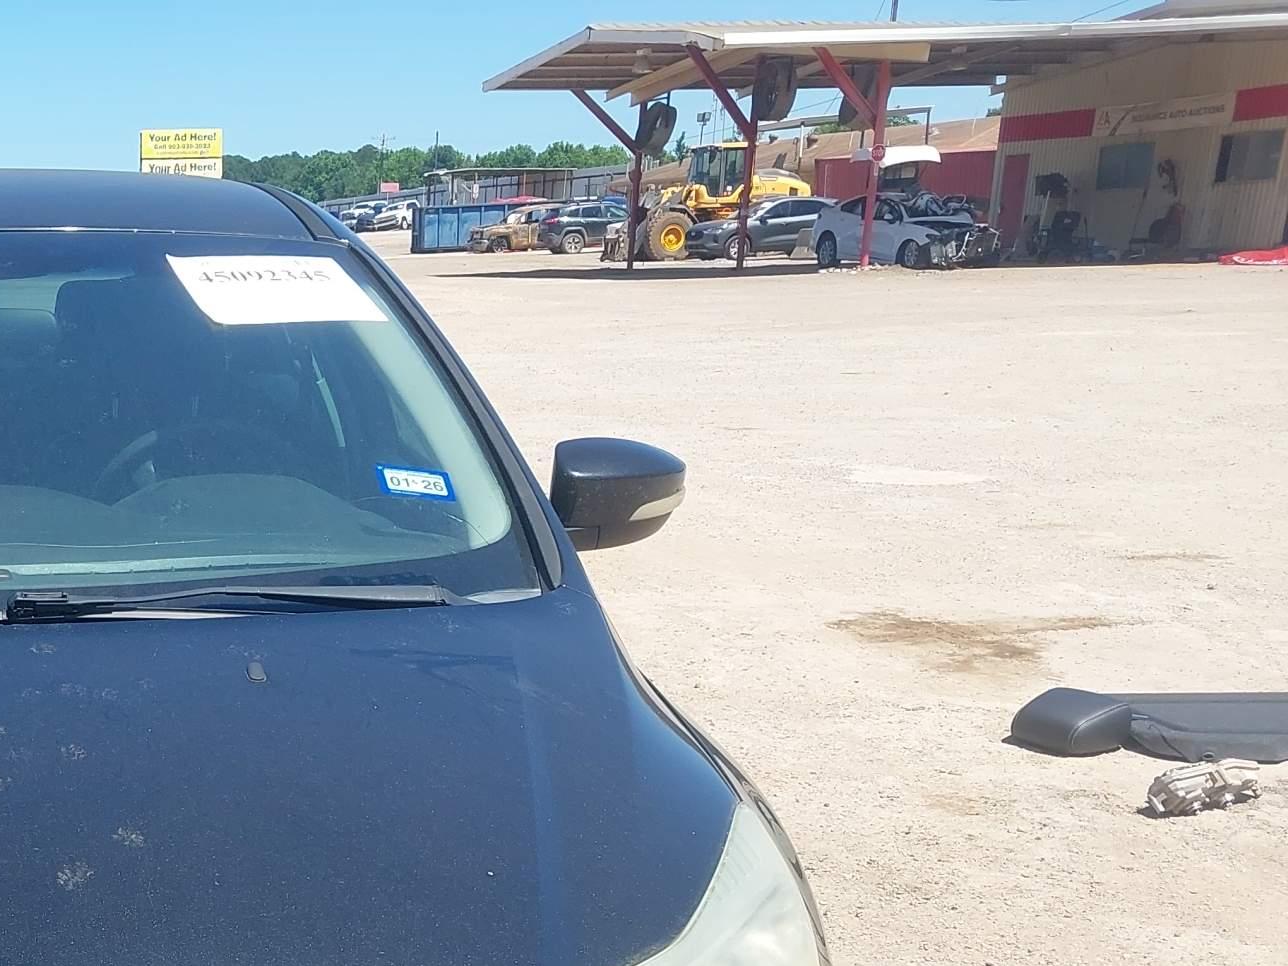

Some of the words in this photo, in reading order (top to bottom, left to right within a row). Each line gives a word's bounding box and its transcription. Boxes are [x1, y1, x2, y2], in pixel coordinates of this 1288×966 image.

[149, 133, 171, 142] Your
[174, 132, 187, 142] Ad
[190, 131, 217, 141] Here!
[149, 163, 171, 174] Your
[174, 162, 187, 172] Ad
[190, 162, 217, 172] Here!
[198, 269, 331, 283] 45092345
[421, 479, 444, 492] 26
